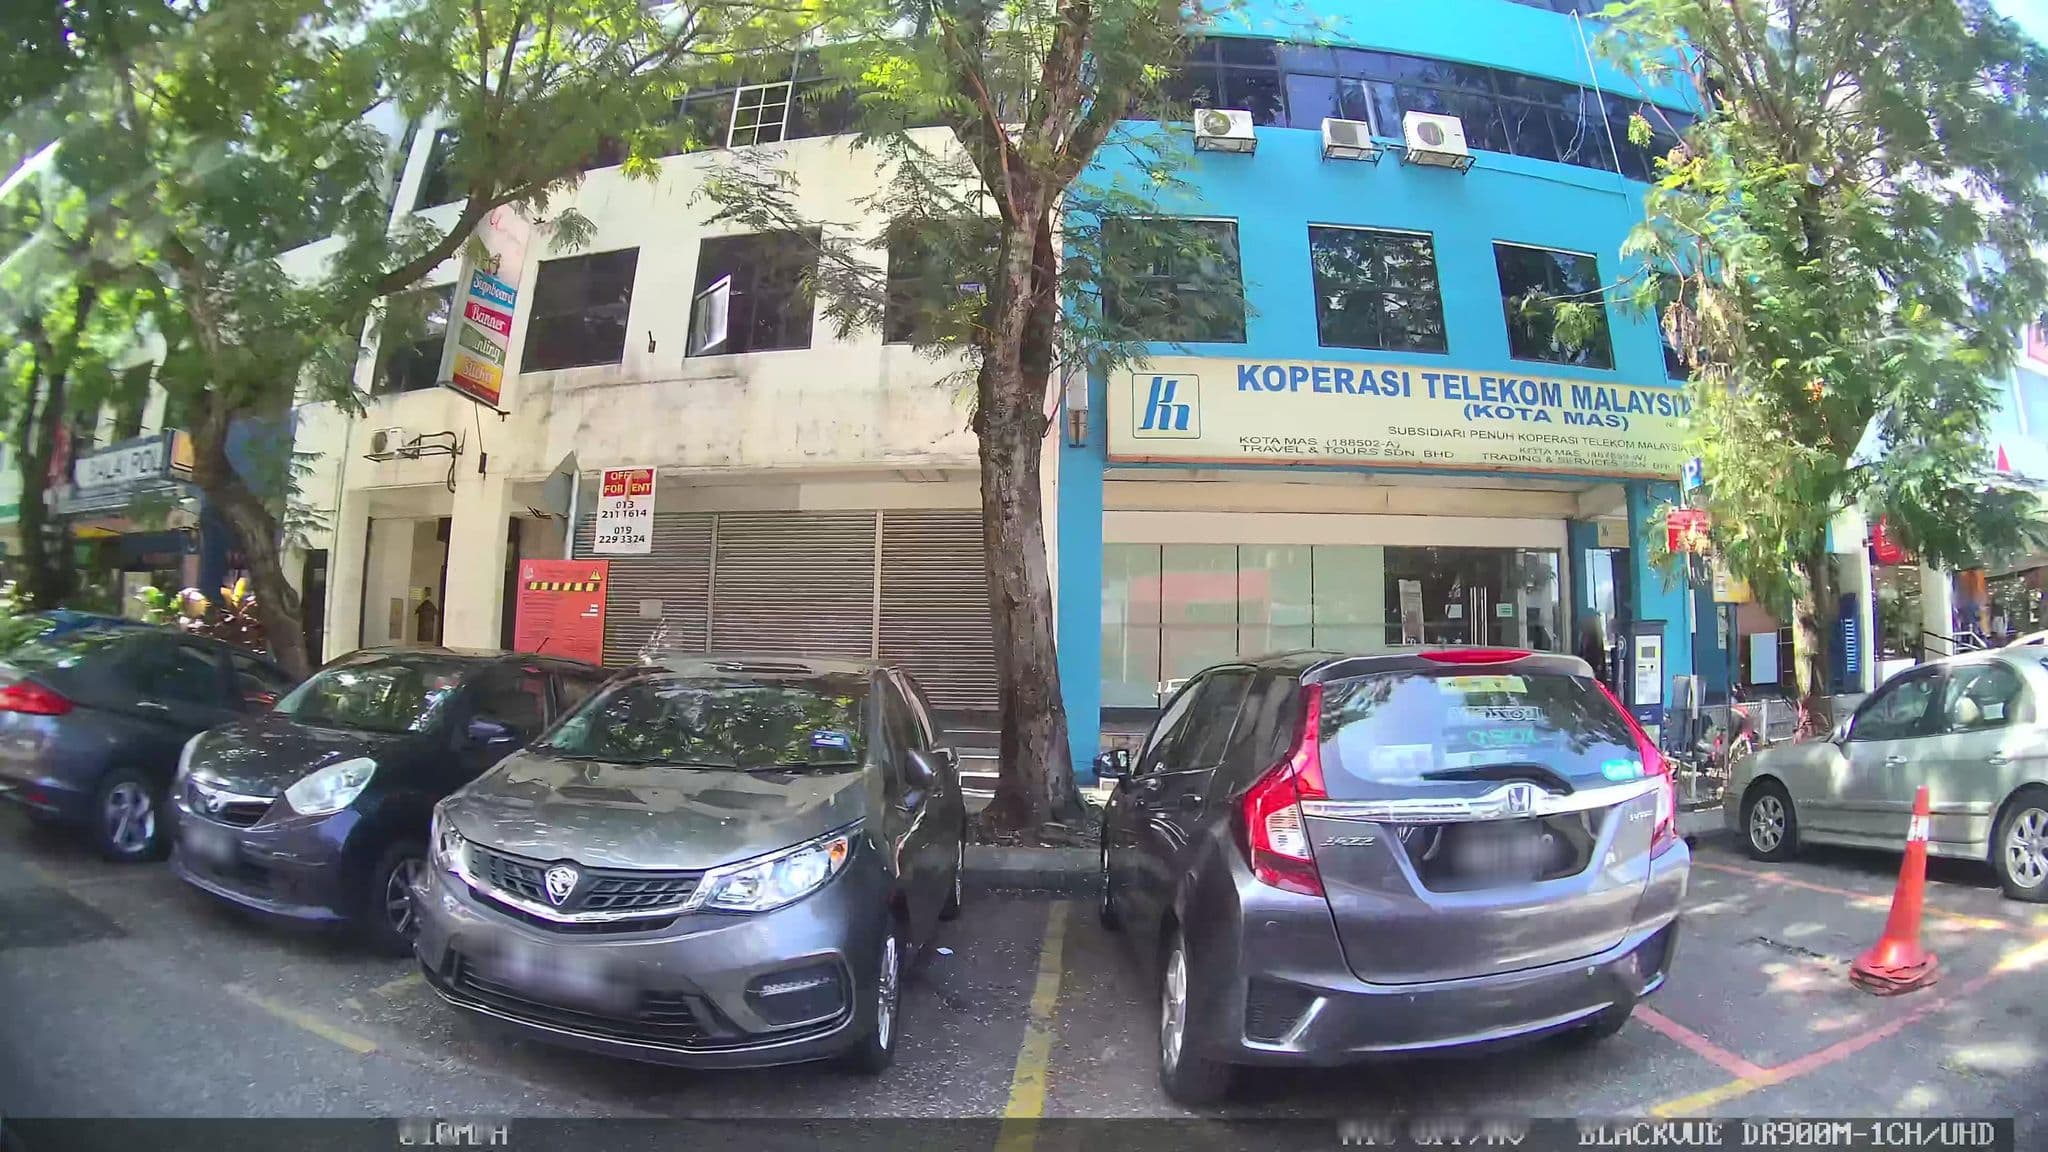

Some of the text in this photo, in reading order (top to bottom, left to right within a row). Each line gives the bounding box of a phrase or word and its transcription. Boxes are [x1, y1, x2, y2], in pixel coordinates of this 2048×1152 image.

[471, 304, 506, 331] Banner
[1237, 364, 1411, 398] KOPERASI
[1421, 373, 1562, 408] TELEKOM
[1464, 403, 1629, 431] (KOTA MAS)
[1239, 436, 1281, 445] KOTA
[1284, 437, 1317, 446] MAS
[1388, 426, 1466, 438] SUBSIDIARI
[1470, 430, 1514, 441] PENUH
[1518, 433, 1578, 445] KOPERASI
[1581, 437, 1635, 449] TELEKOM
[1241, 445, 1454, 458] TRAVEL & TOURS SDN BHD
[1519, 447, 1551, 456] KOTA
[1555, 449, 1581, 457] MAS
[1482, 453, 1541, 463] TRADING
[604, 483, 652, 494] FOR ENT
[616, 501, 634, 509] 013
[601, 509, 647, 519] 211 1614
[614, 526, 632, 535] 019
[599, 535, 645, 544] 229 3324
